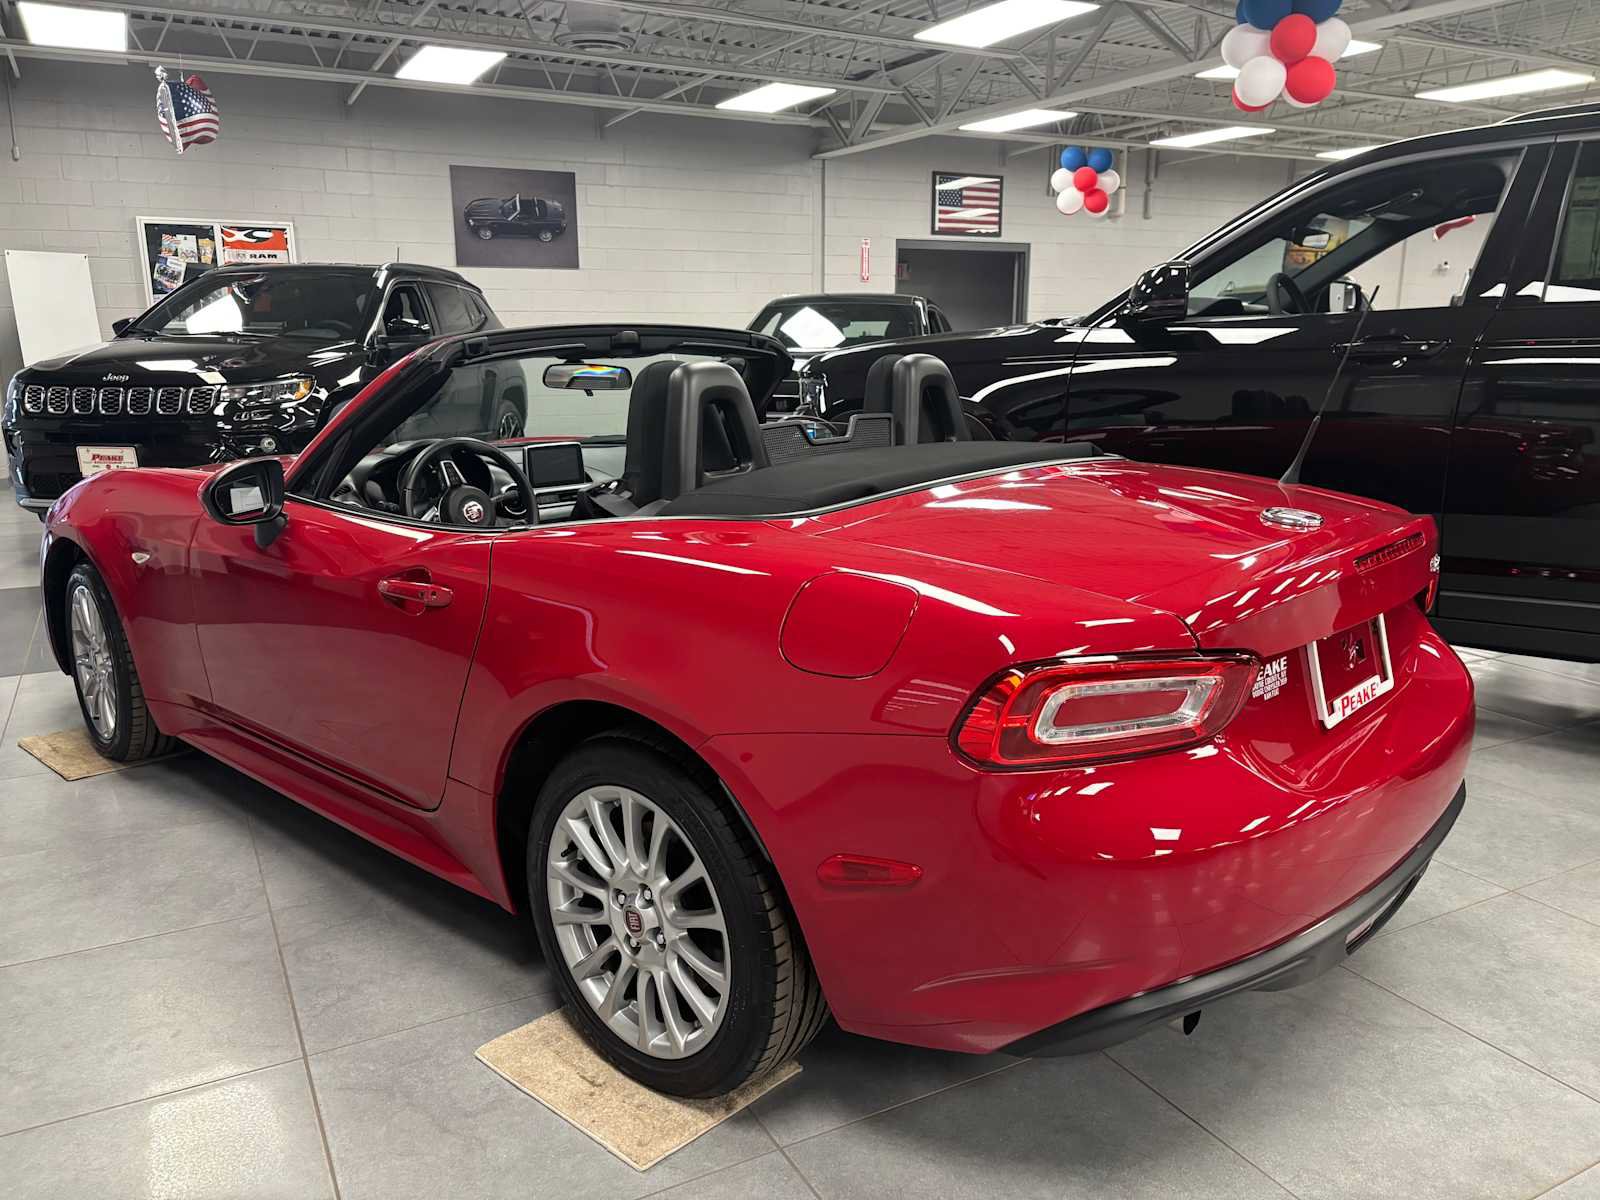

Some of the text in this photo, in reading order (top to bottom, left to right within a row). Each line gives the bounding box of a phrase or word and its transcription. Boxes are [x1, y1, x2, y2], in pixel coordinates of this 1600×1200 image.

[102, 372, 130, 383] Jeep
[91, 454, 124, 462] PEAKE
[1256, 656, 1288, 682] EAKE
[1340, 681, 1377, 718] PEAKE
[628, 911, 641, 931] FIAT
